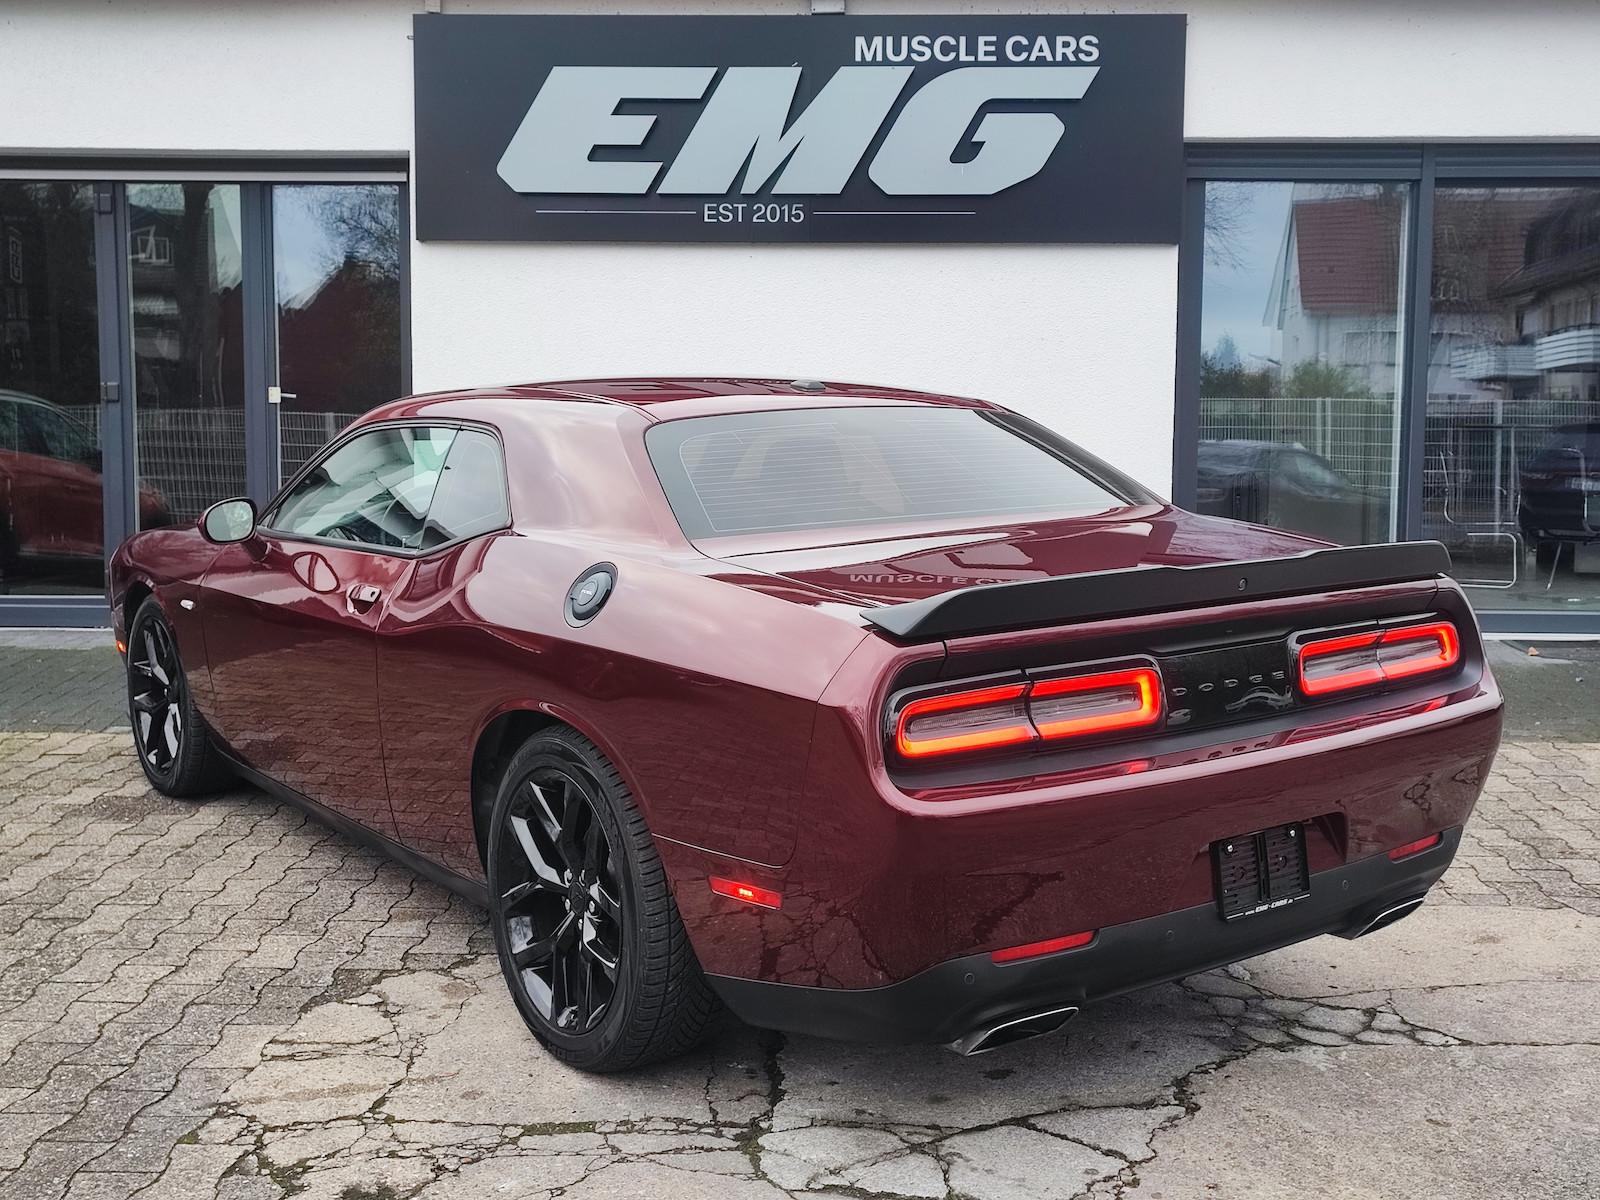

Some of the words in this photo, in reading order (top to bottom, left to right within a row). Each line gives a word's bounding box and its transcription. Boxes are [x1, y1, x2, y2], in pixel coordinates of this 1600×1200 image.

[854, 35, 998, 62] MUSCLE
[1005, 35, 1100, 62] CARS
[496, 66, 1101, 195] EMG
[703, 203, 747, 223] EST
[752, 203, 805, 223] 2015
[1172, 670, 1285, 696] DODGE
